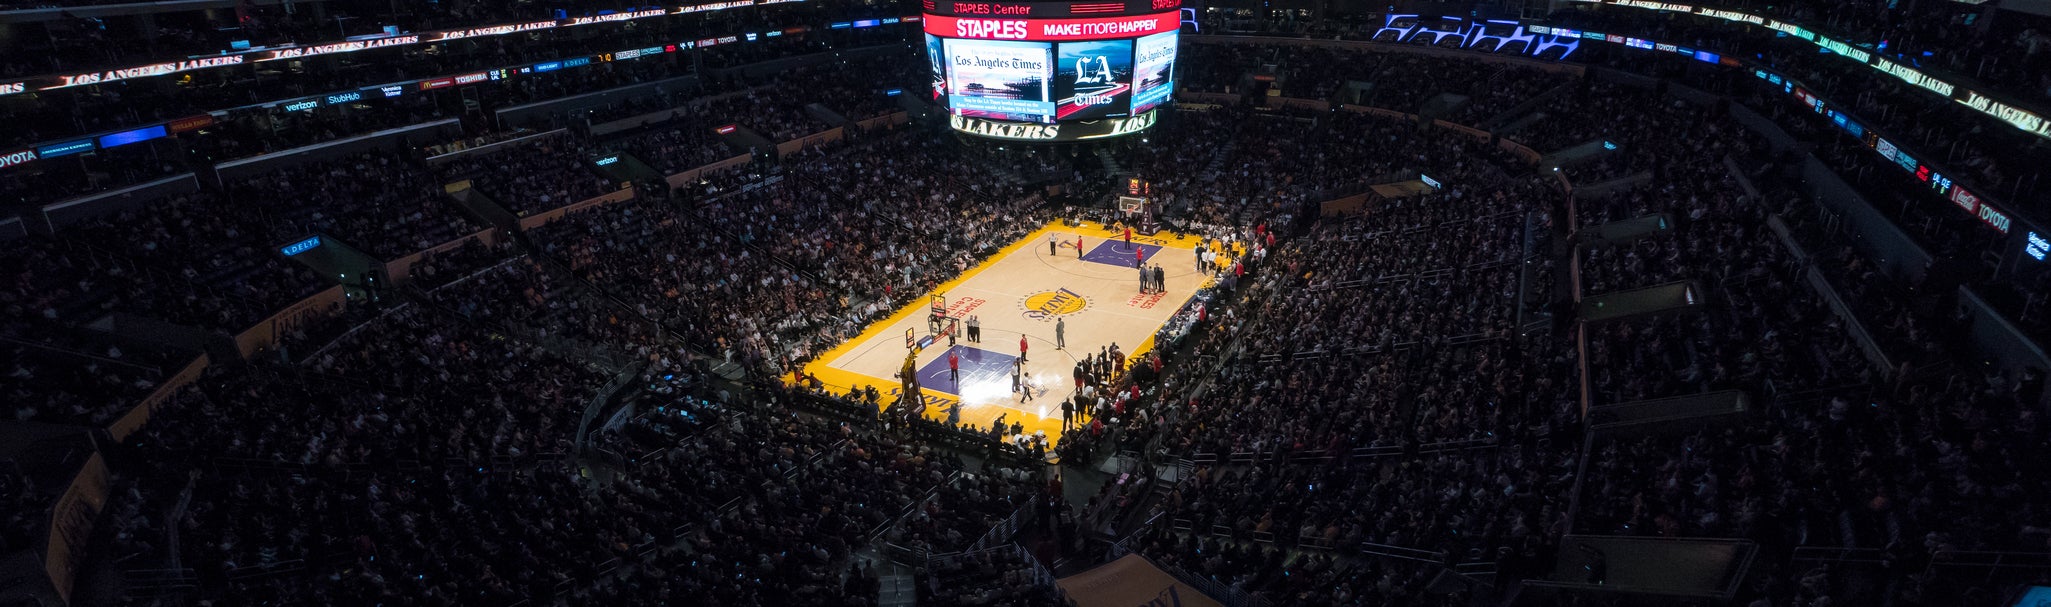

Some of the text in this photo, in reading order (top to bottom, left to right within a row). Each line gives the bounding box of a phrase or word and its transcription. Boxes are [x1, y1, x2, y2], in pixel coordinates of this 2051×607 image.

[699, 2, 727, 11] ANGELES
[953, 3, 1031, 14] STAPLES Center
[1630, 1, 1661, 9] ANGELES
[1661, 3, 1692, 12] LAKERS
[1702, 8, 1714, 16] LOS
[575, 9, 666, 24] LOS ANGELES LAKERS
[442, 21, 557, 40] LOS ANGELES LAKERS
[956, 18, 1028, 38] STAPLES
[1043, 19, 1158, 35] MAKE more HAPPEN
[718, 36, 737, 44] TOYOTA
[272, 36, 419, 59] LOS ANGELES LAKERS
[1655, 43, 1677, 52] TOYOTA
[616, 50, 640, 60] STAPLES
[955, 55, 1042, 69] Los Angeles Times
[62, 55, 243, 87] LOS ANGELES LAKERS
[1074, 55, 1115, 84] LA
[1878, 57, 1954, 96] LOS ANGELES LAKERS
[455, 72, 488, 84] TOSHIBA
[328, 92, 360, 104] StubHub
[1073, 92, 1113, 106] Times
[286, 100, 317, 112] verizon
[1969, 91, 1991, 111] LOS
[1987, 102, 2041, 131] ANGELES
[963, 118, 1060, 139] LAKERS
[1111, 117, 1147, 135] LOS
[69, 142, 92, 150] EXPRESS
[595, 156, 618, 167] verizon
[1978, 203, 2010, 234] TOYOTA
[291, 238, 319, 253] DELTA
